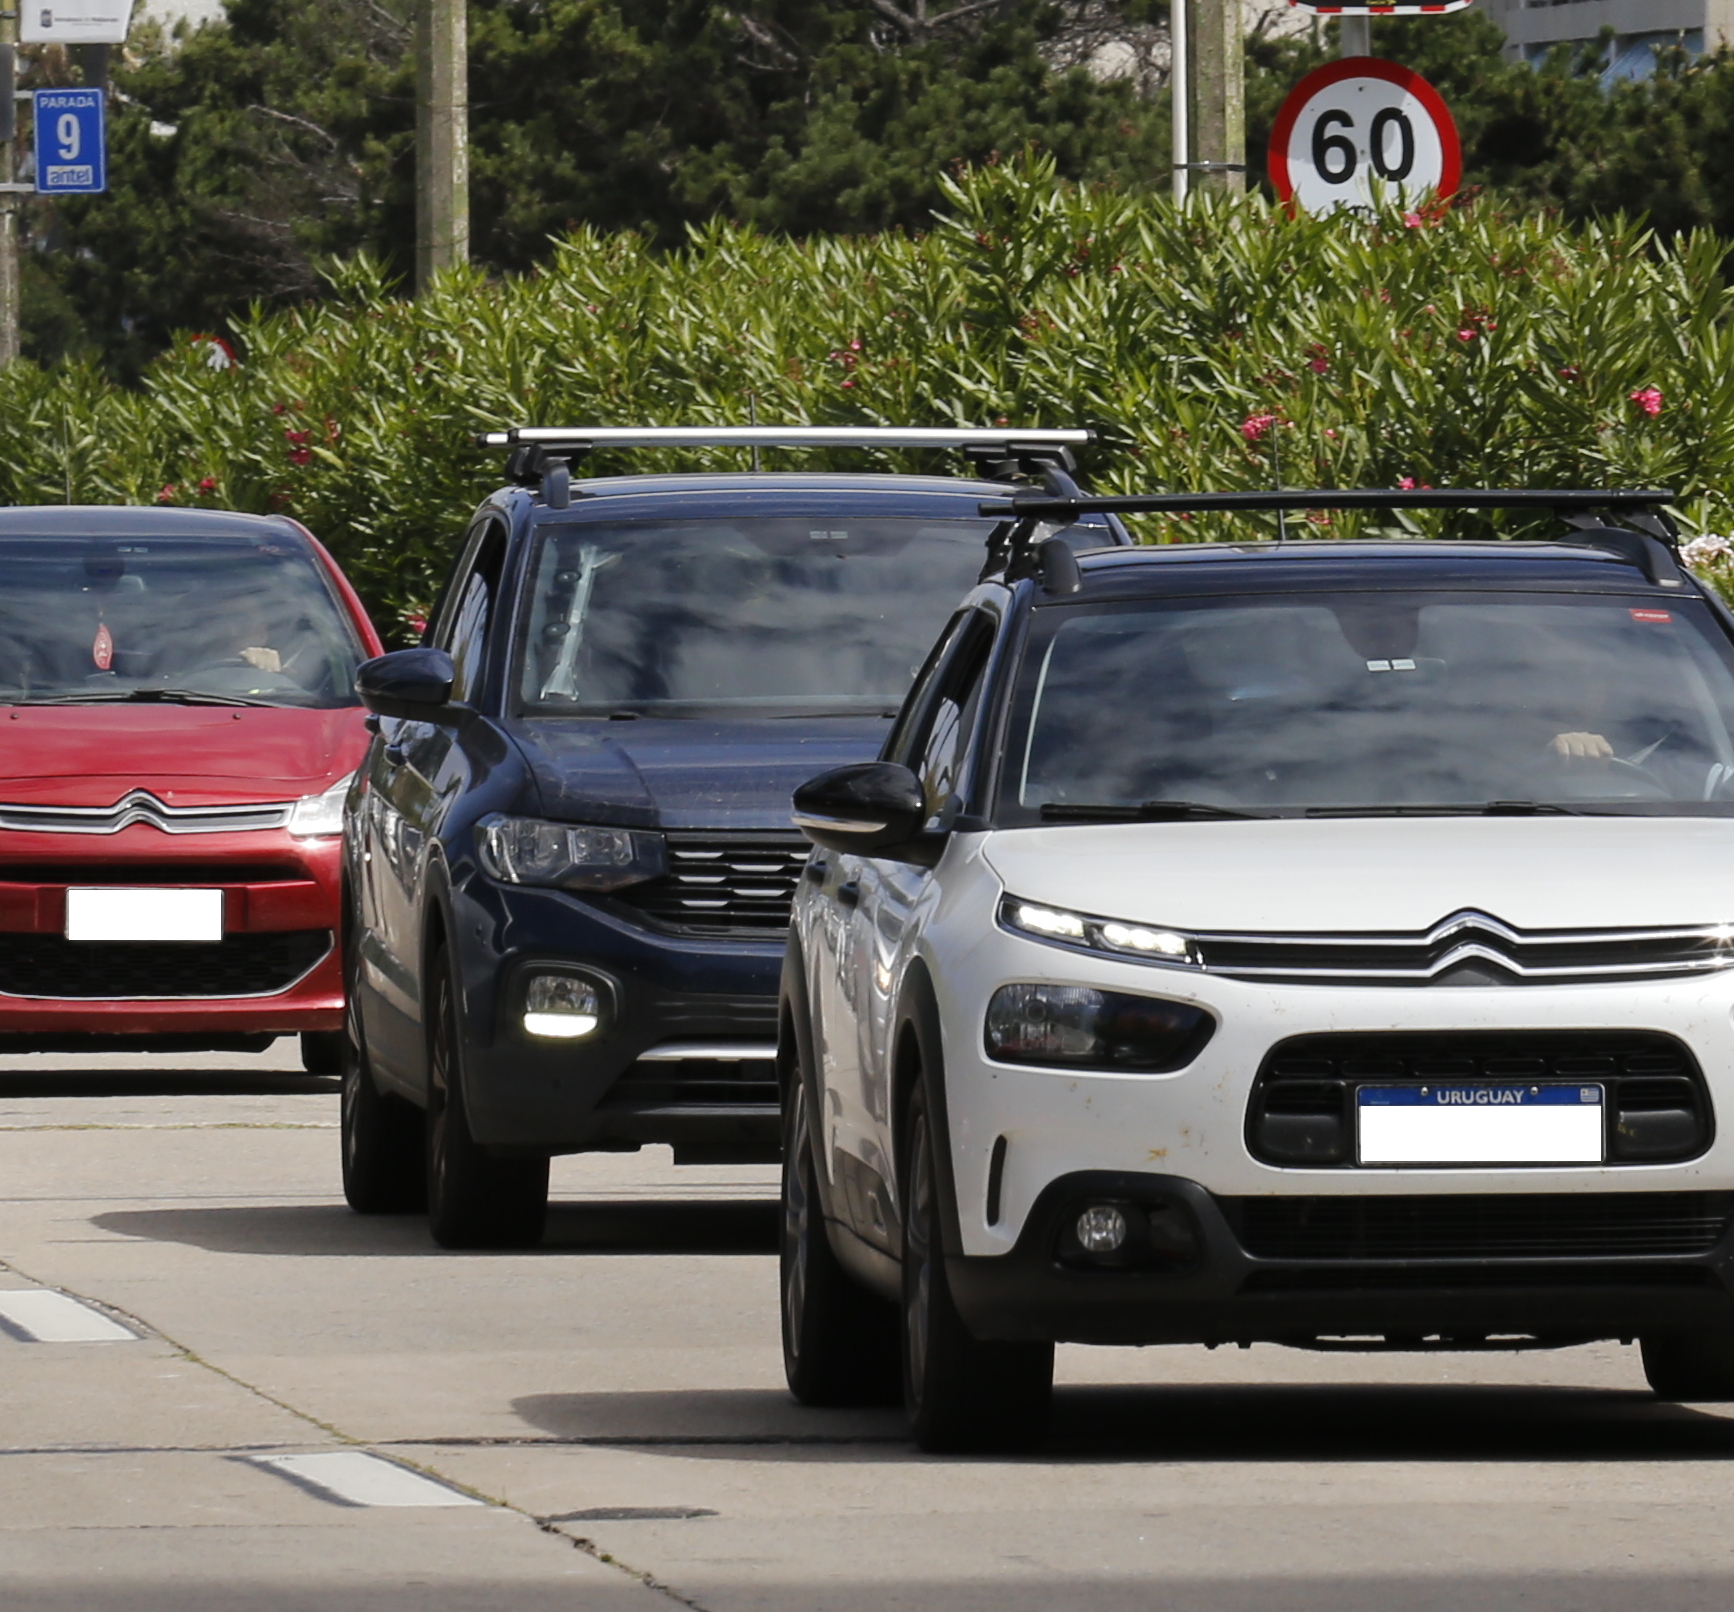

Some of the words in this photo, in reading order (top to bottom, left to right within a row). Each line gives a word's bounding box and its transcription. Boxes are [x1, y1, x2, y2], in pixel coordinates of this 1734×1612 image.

[39, 96, 95, 108] PARADA
[57, 113, 81, 160] 9
[1312, 106, 1415, 185] 60
[1437, 1090, 1524, 1104] URUGUAY
